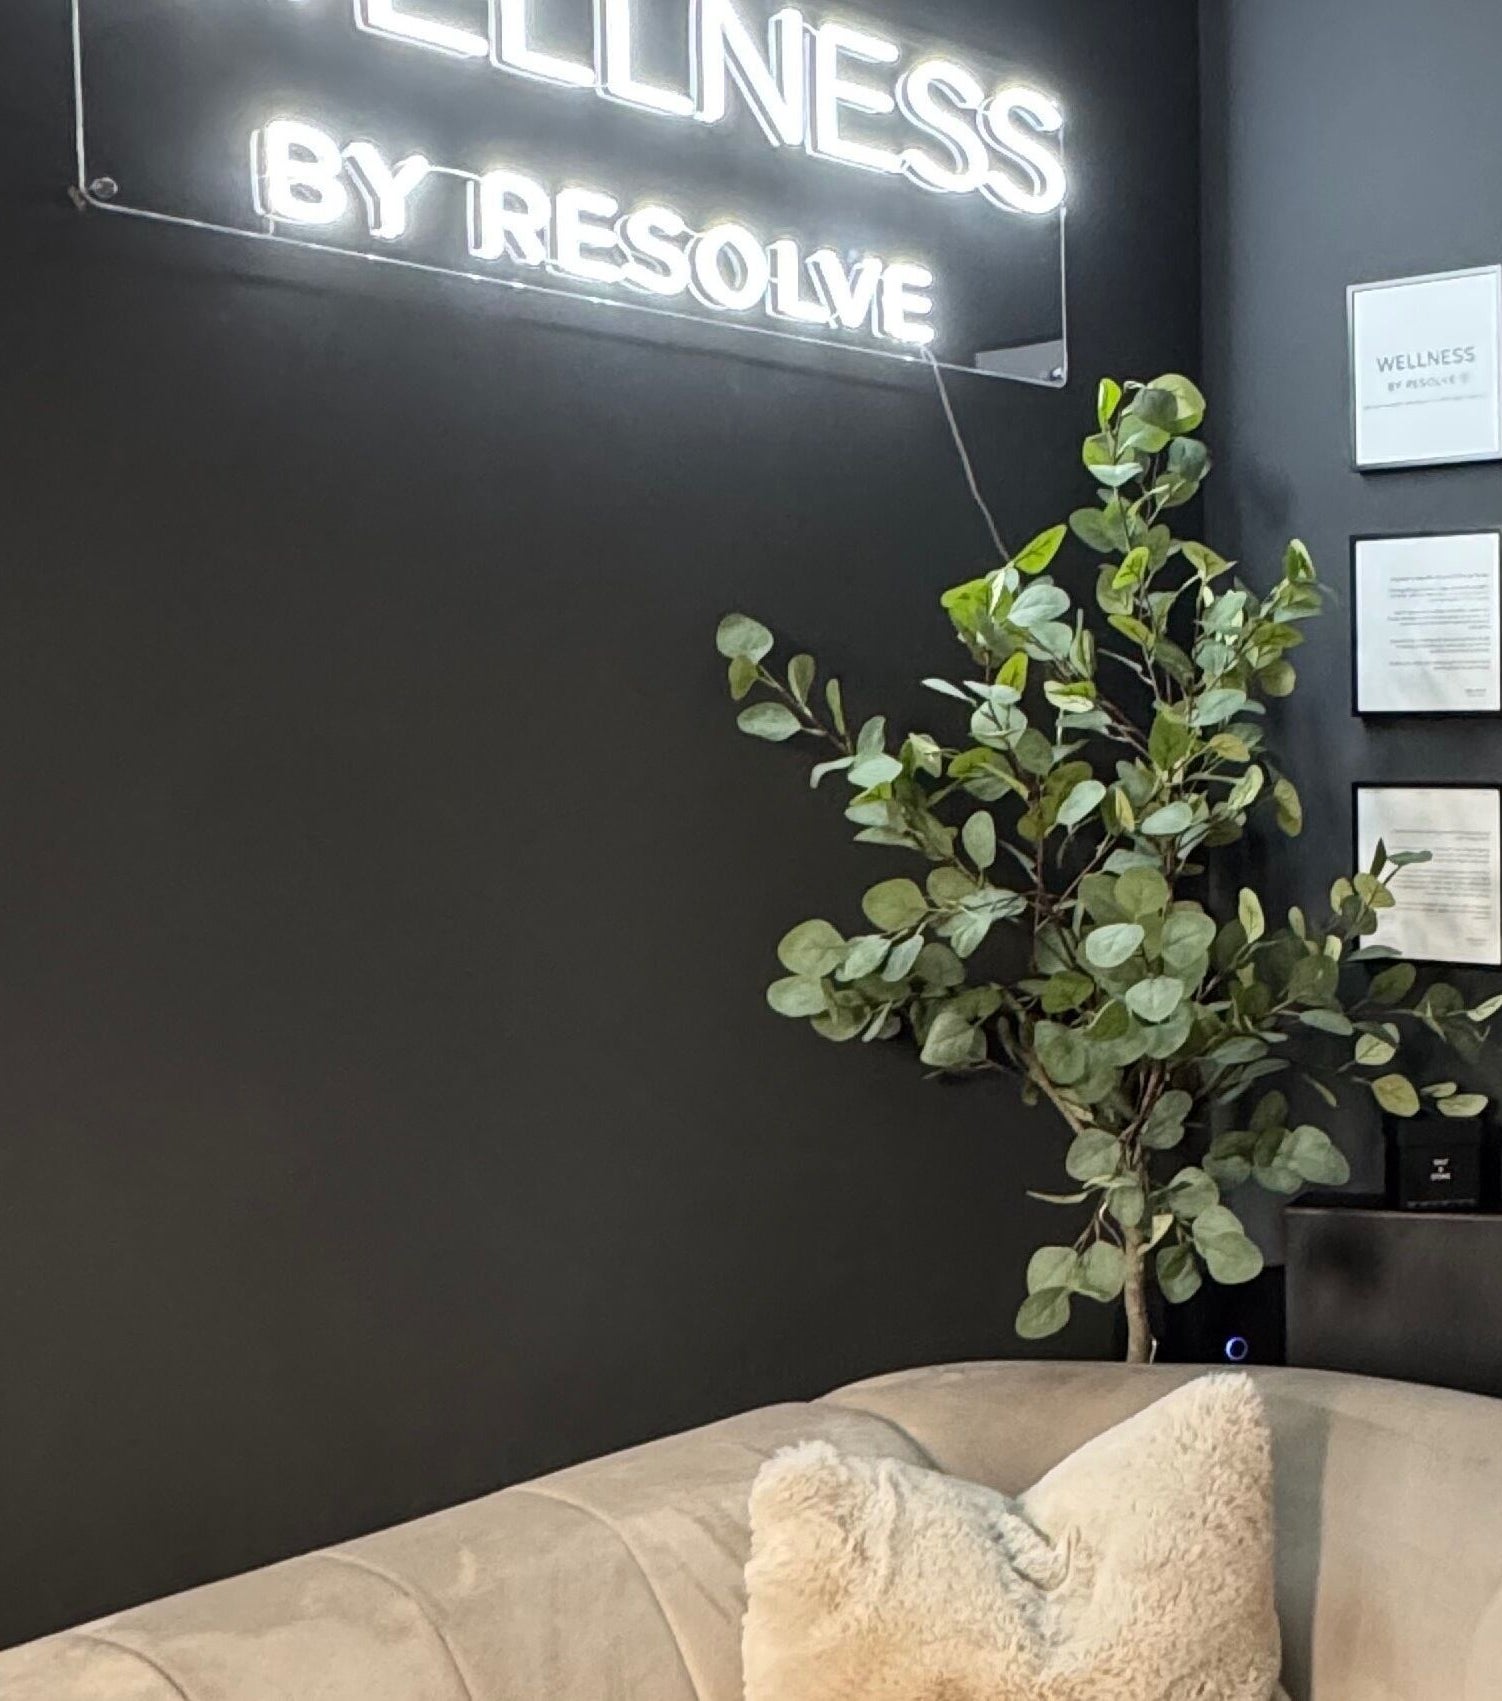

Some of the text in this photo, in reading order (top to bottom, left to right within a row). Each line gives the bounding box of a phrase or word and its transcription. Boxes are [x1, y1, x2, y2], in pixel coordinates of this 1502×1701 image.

[250, 118, 936, 346] BY RESOLVE
[1376, 346, 1476, 373] WELLNESS
